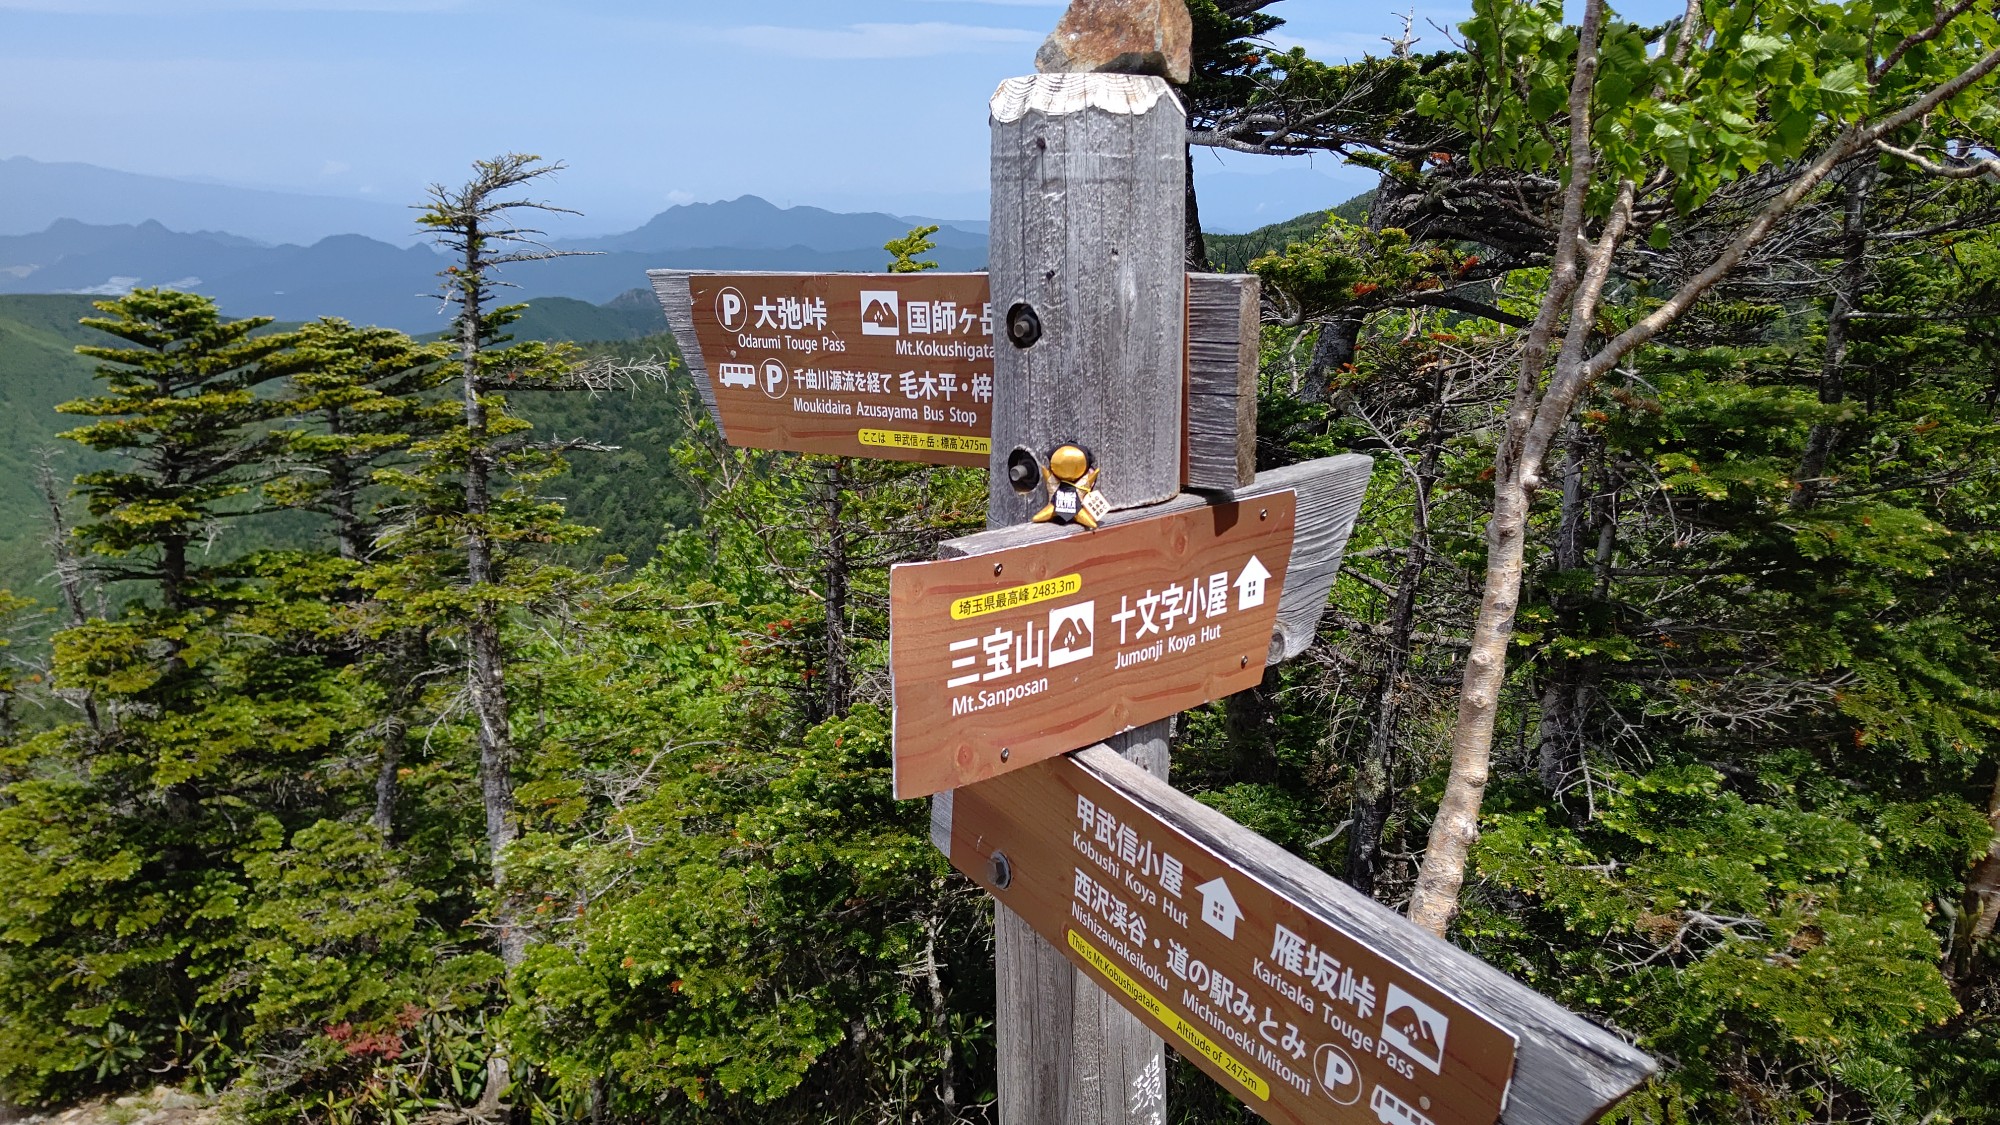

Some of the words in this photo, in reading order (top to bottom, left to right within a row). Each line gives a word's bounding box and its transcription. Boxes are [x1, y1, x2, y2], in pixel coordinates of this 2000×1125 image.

[723, 293, 741, 327] P
[754, 296, 827, 330] 大弛峠
[738, 334, 780, 349] Odarumi
[785, 335, 817, 354] Touge
[823, 337, 845, 351] Pass
[766, 363, 783, 393] P
[793, 367, 891, 394] 千曲川源流を経て
[794, 397, 851, 415] Moukidaira
[857, 402, 918, 421] Azusayama
[924, 406, 944, 421] Bus
[950, 407, 976, 427] Stop
[1112, 571, 1228, 644] 十文字小屋
[947, 621, 1043, 688] 三宝山
[1115, 641, 1163, 669] Jumonji
[1168, 634, 1196, 653] Koya
[1201, 625, 1221, 642] Hut
[952, 678, 1048, 716] Mt.Sanposan
[1077, 795, 1183, 898] 甲武信小屋
[1073, 831, 1119, 878] Kobushi
[1126, 870, 1156, 905] Koya
[1163, 897, 1188, 928] Hut
[1270, 924, 1375, 1018] 雁坂峠
[1072, 901, 1168, 991] Nishizawakeikoku
[1183, 990, 1255, 1055] Michinoeki
[1258, 1045, 1310, 1096] Mitomi
[1072, 934, 1087, 953] This
[1086, 945, 1093, 960] is
[1094, 953, 1162, 1015] Mt.Kobushigatake
[1176, 1021, 1210, 1055] Altitude
[1212, 1047, 1223, 1063] of
[1226, 1058, 1257, 1090] 2475m
[1253, 958, 1313, 1013] Karisaka
[1323, 1003, 1372, 1052] Touge
[1377, 1038, 1413, 1079] Pass
[1324, 1050, 1353, 1091] P
